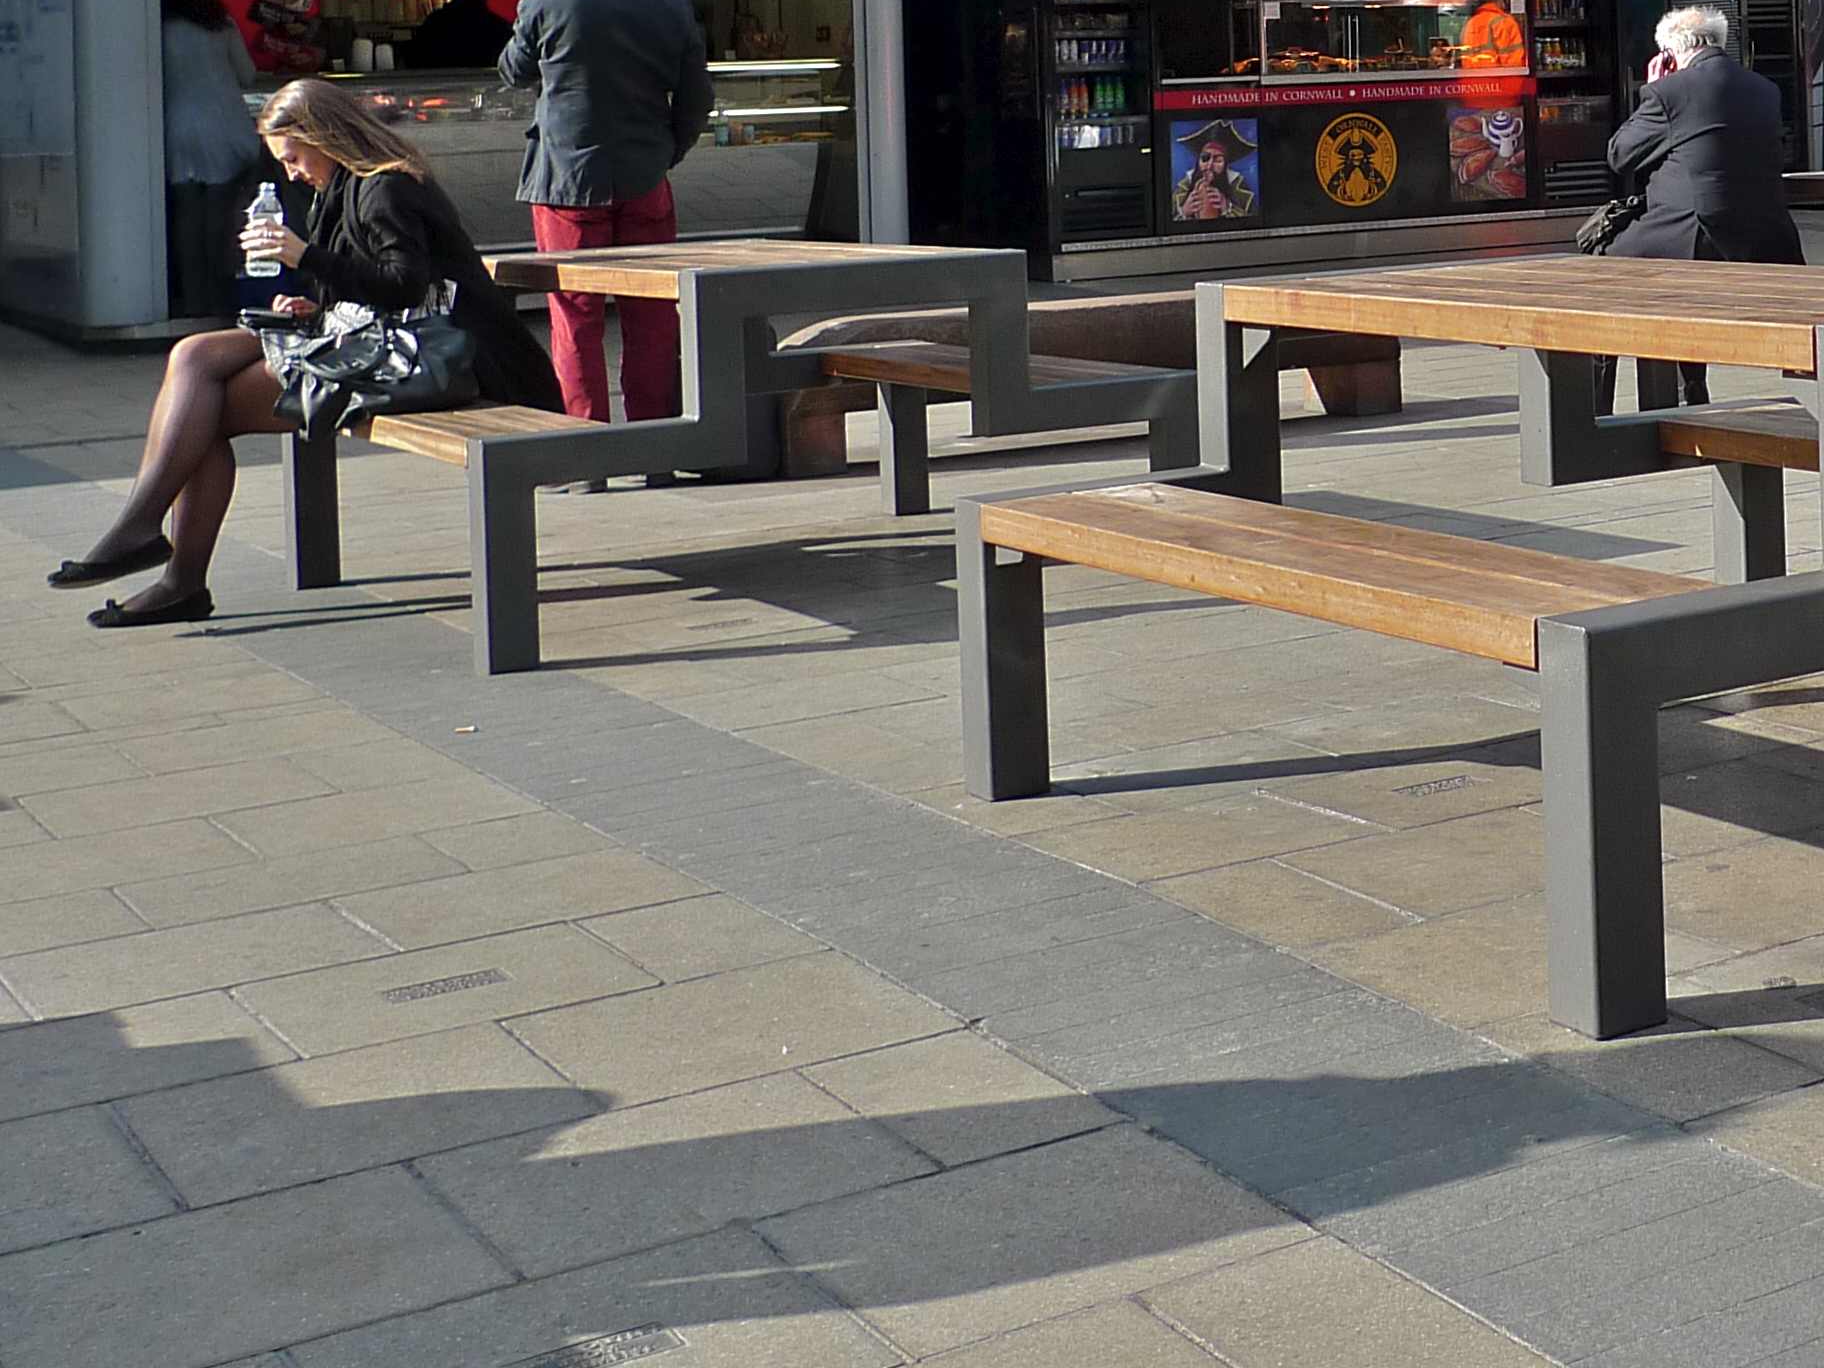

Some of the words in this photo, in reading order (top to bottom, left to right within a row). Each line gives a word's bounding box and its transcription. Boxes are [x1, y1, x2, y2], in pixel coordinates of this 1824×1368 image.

[1192, 92, 1261, 105] HANDMADE
[1265, 91, 1279, 102] IN
[1283, 89, 1343, 101] CORNWALL
[1362, 85, 1425, 98] HANDMADE
[1429, 85, 1441, 95] IN
[1445, 82, 1502, 95] CORNWALL
